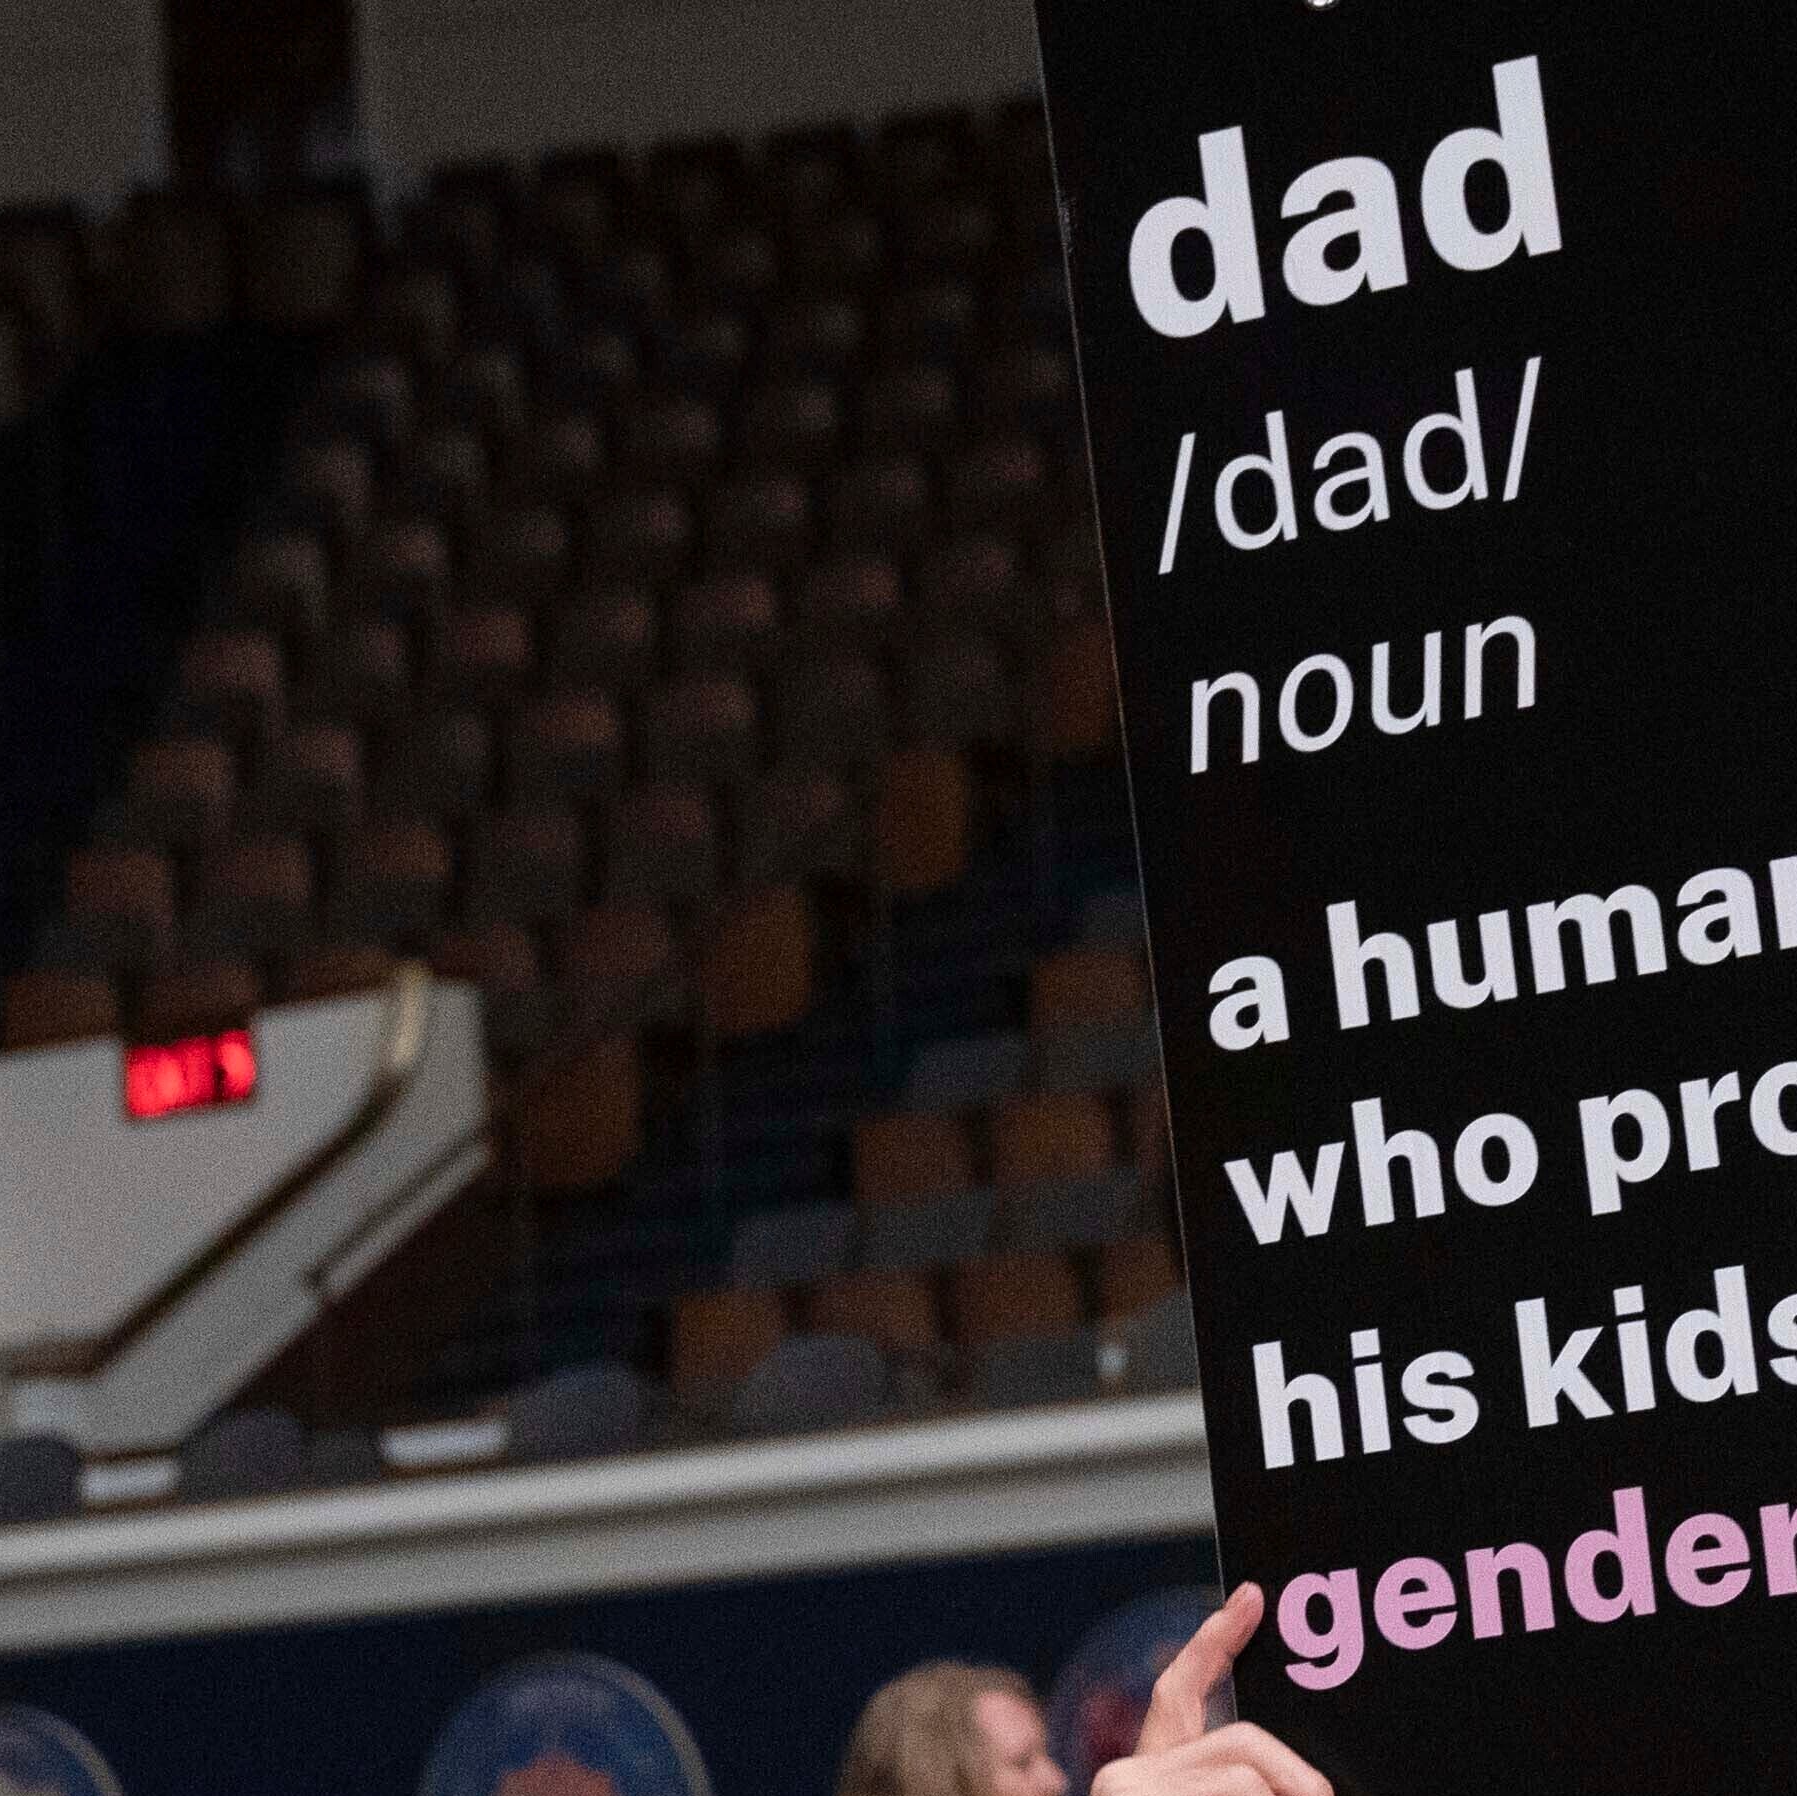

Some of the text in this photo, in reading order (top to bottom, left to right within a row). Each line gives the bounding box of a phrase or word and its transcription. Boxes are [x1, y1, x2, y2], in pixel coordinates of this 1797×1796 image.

[1128, 54, 1562, 338] dad
[1157, 355, 1543, 576] /dad/
[1189, 614, 1537, 775] noun
[1208, 955, 1290, 1051] a
[1223, 1097, 1539, 1245] who
[1252, 1328, 1481, 1470] his
